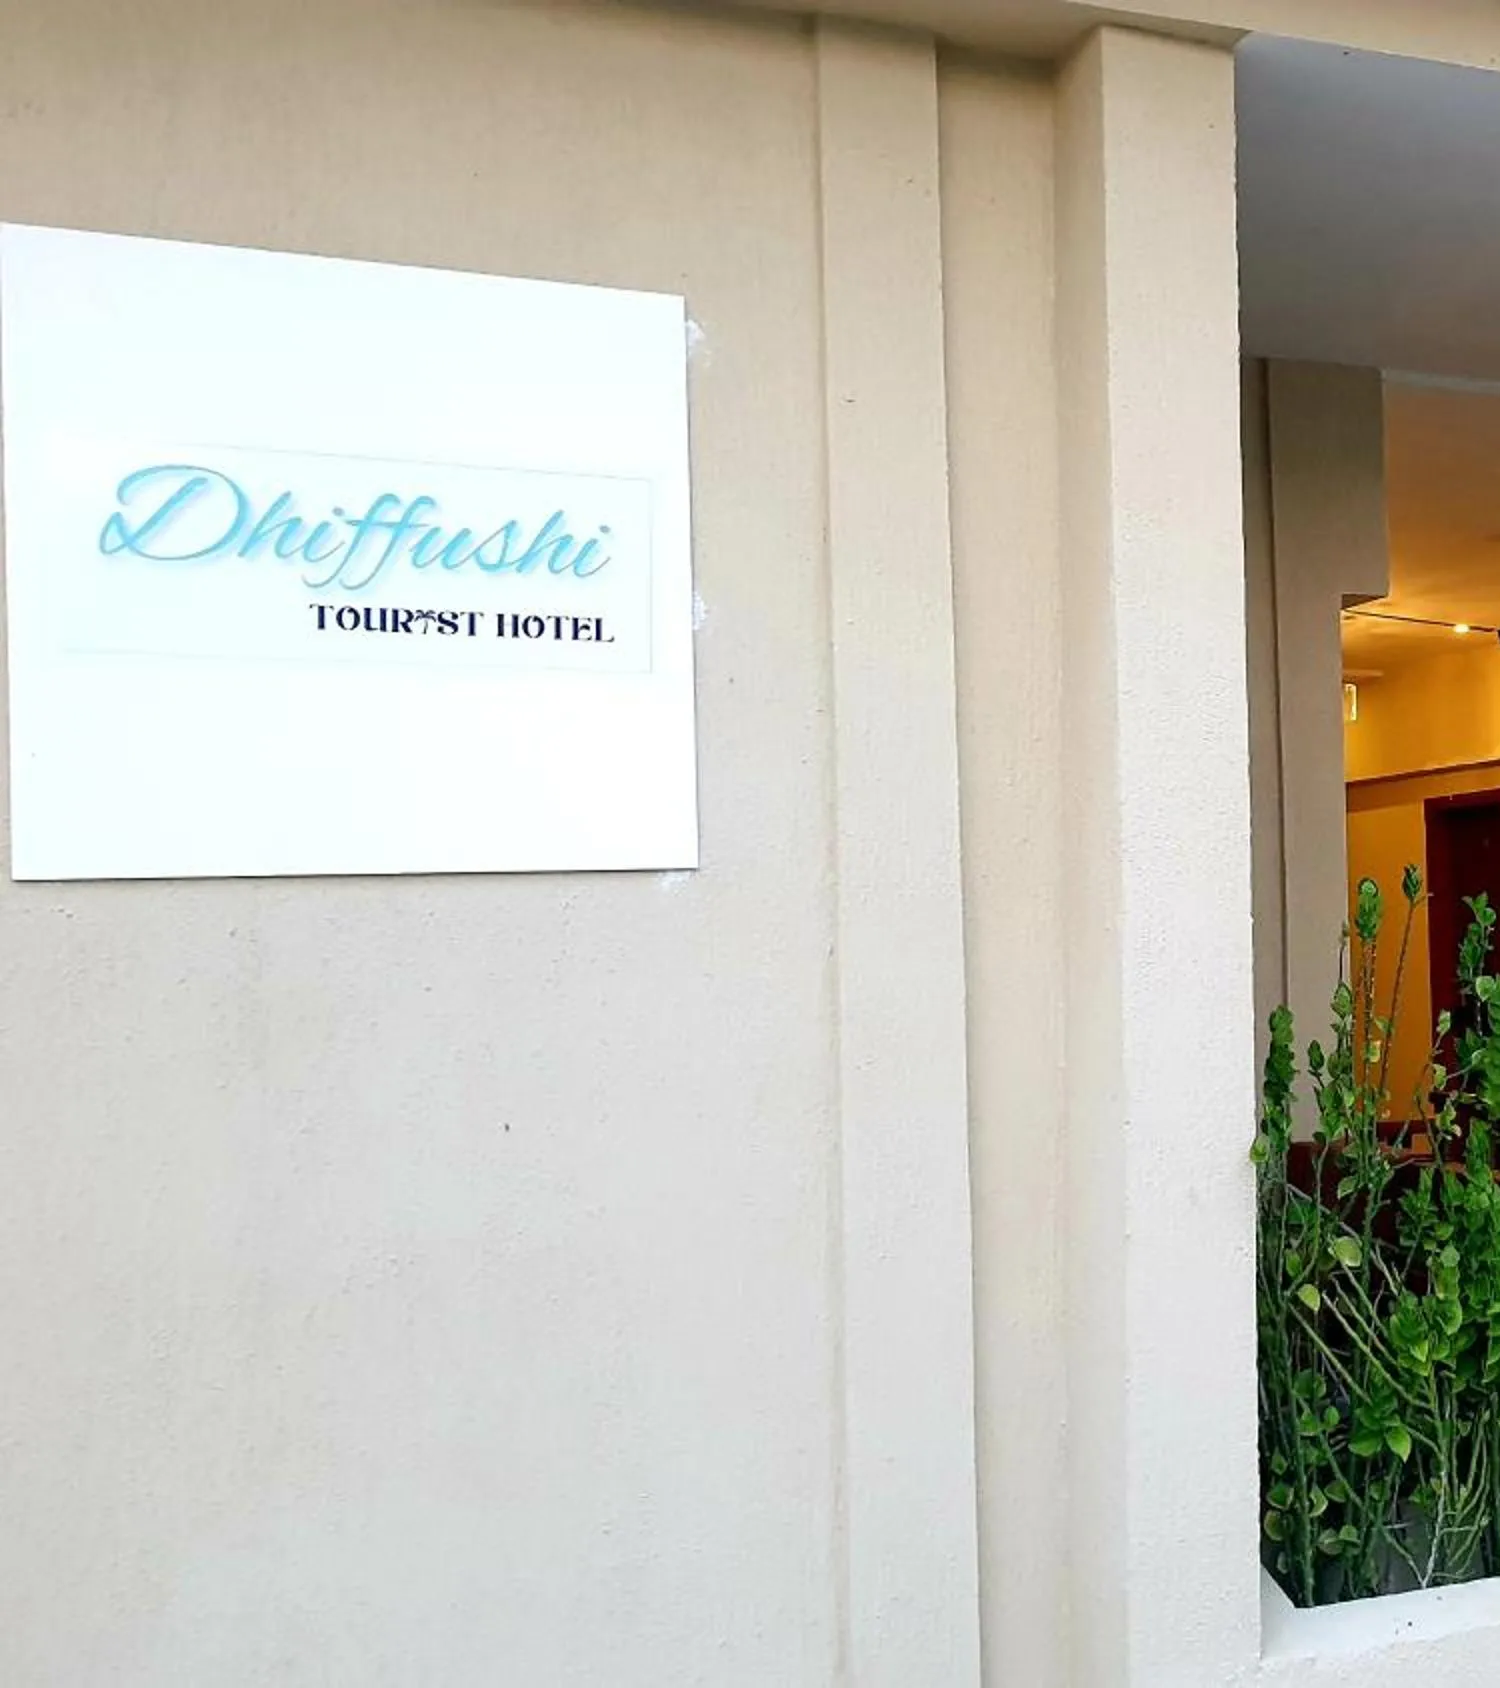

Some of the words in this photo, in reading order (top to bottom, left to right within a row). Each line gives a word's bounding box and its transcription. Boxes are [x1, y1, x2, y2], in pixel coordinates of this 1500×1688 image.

[99, 464, 611, 591] Dhiffushi
[309, 603, 484, 636] TOURIST
[496, 613, 615, 643] HOTEL
